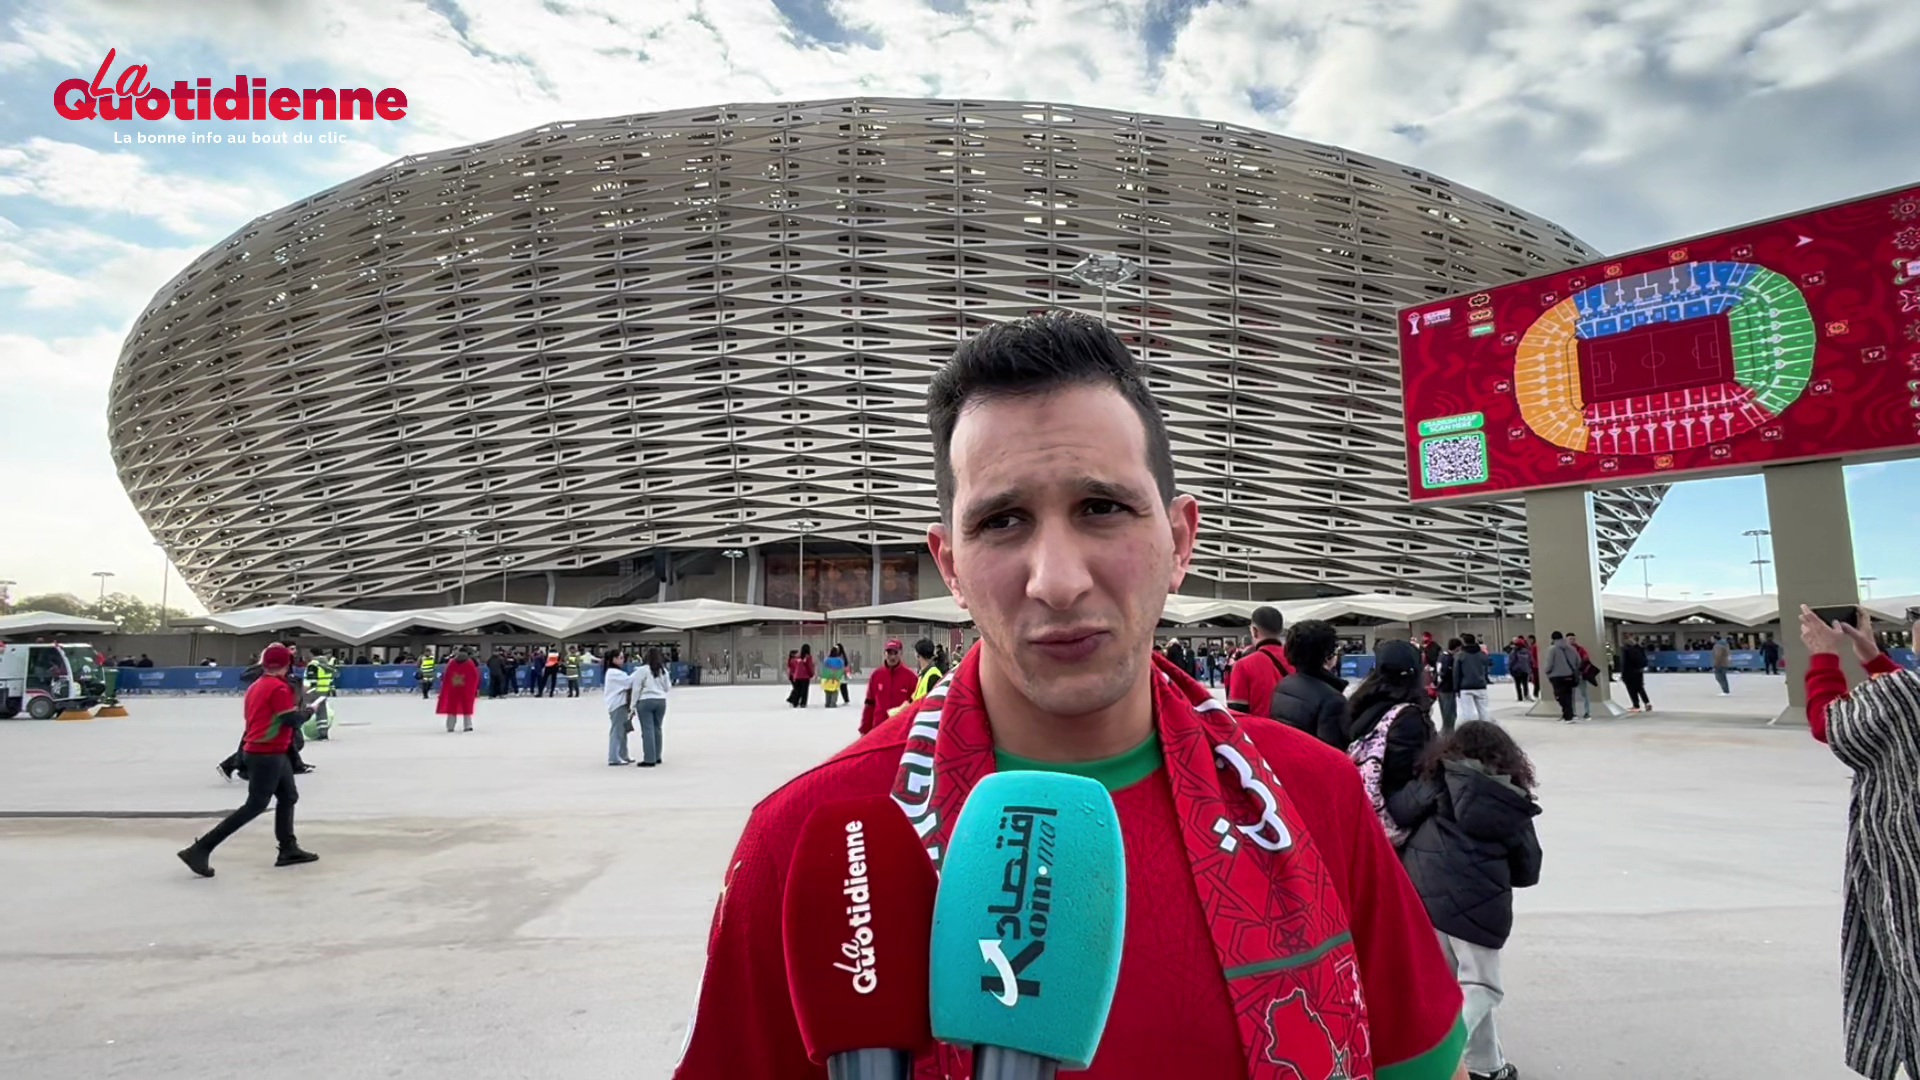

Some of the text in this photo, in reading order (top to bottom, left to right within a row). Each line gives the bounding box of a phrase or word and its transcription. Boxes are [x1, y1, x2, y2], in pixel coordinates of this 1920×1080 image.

[832, 819, 878, 995] La Quotidienne
[987, 805, 1058, 940] اقتصاد
